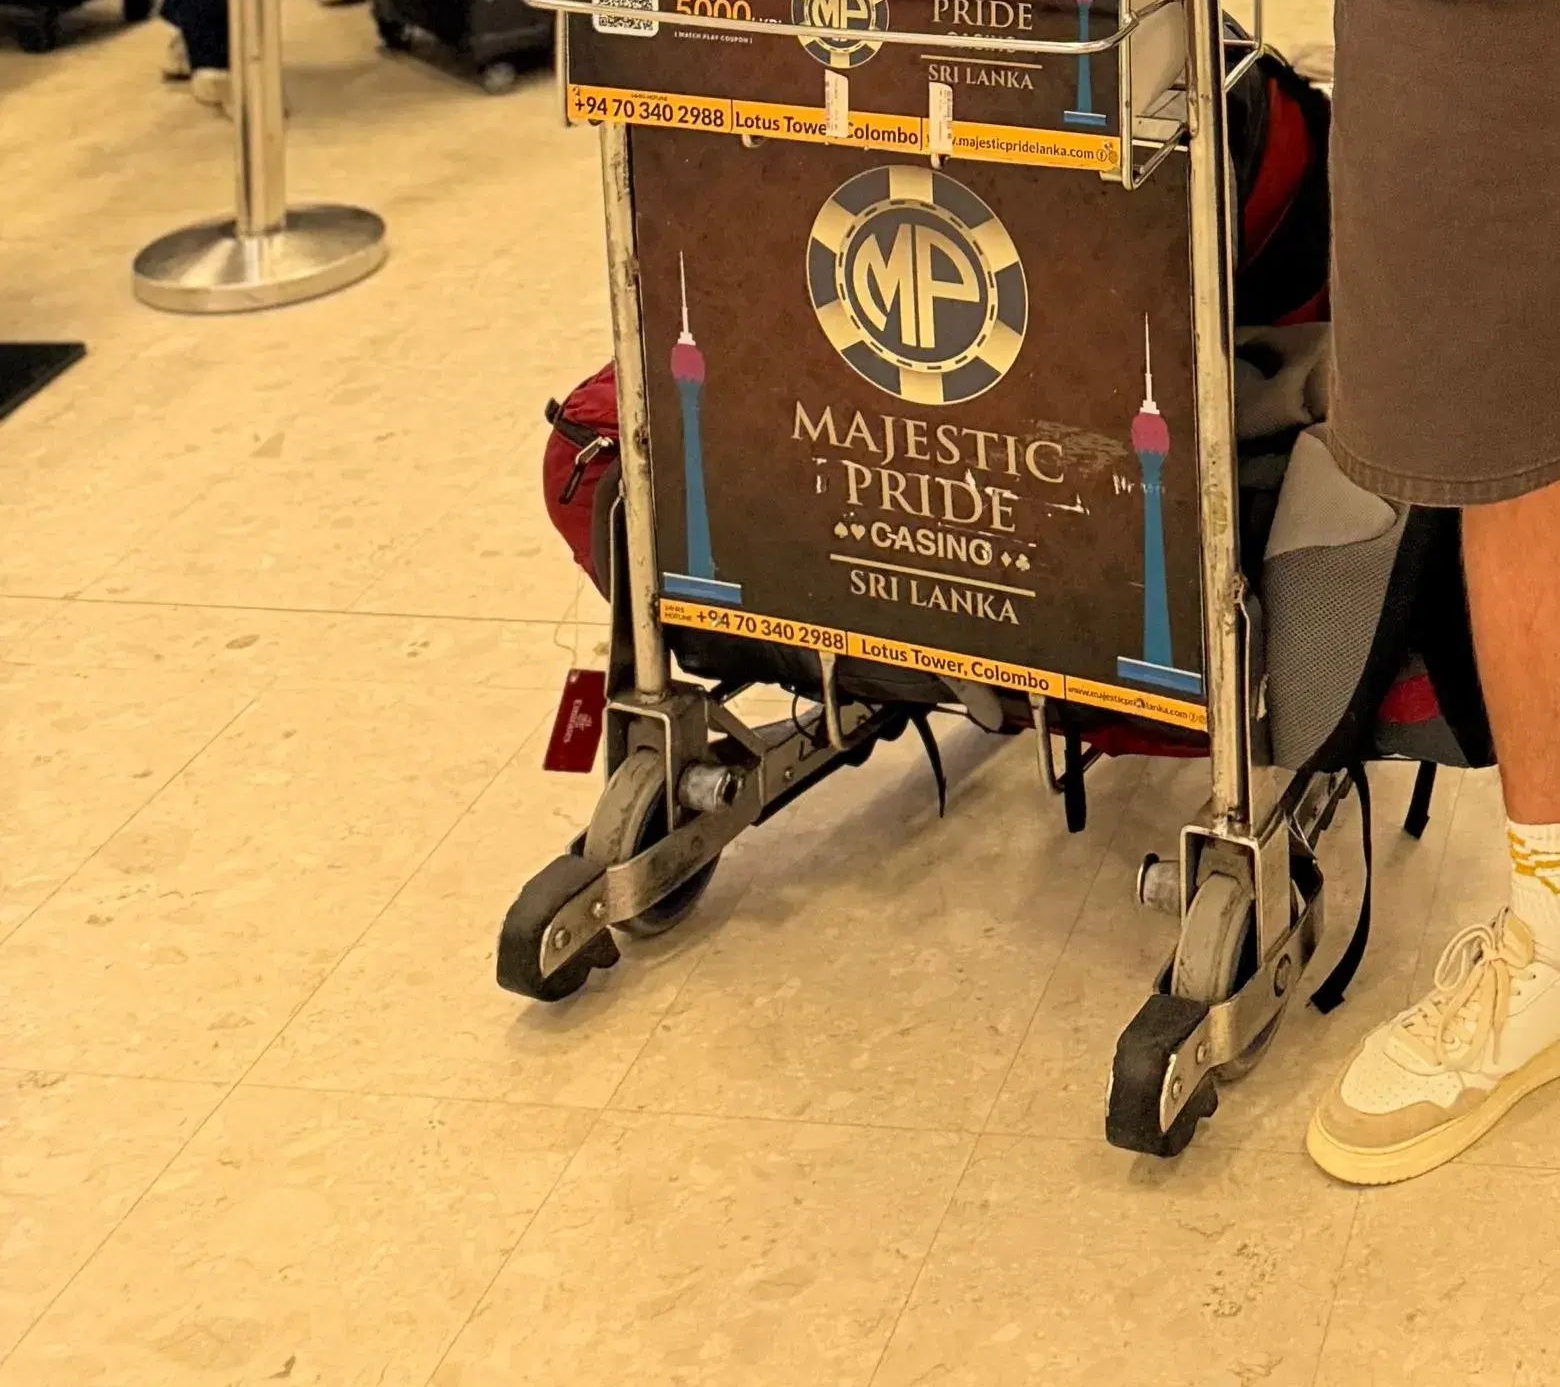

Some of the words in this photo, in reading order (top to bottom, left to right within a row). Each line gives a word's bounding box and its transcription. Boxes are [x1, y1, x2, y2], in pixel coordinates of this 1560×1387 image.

[928, 64, 959, 83] SRI
[966, 67, 1035, 90] LANKA
[575, 96, 608, 116] +94
[612, 99, 635, 119] 70
[639, 101, 674, 122] 340
[677, 105, 724, 128] 2988
[736, 111, 781, 131] Lotus
[784, 116, 827, 136] Towe
[927, 134, 1094, 161] .majesticpridelanka.com
[853, 223, 980, 348] MP
[790, 400, 1064, 484] MAJESTIC
[840, 459, 1016, 533] PRIDE
[870, 521, 993, 567] CASINO
[850, 569, 899, 602] SRI
[909, 580, 1020, 626] LANKA
[696, 609, 730, 629] +94
[734, 614, 757, 633] 70
[761, 619, 795, 641] 340
[799, 626, 844, 650] 2988
[862, 638, 908, 663] Lotus
[911, 648, 968, 677] Tower,
[971, 661, 1050, 691] Colombo
